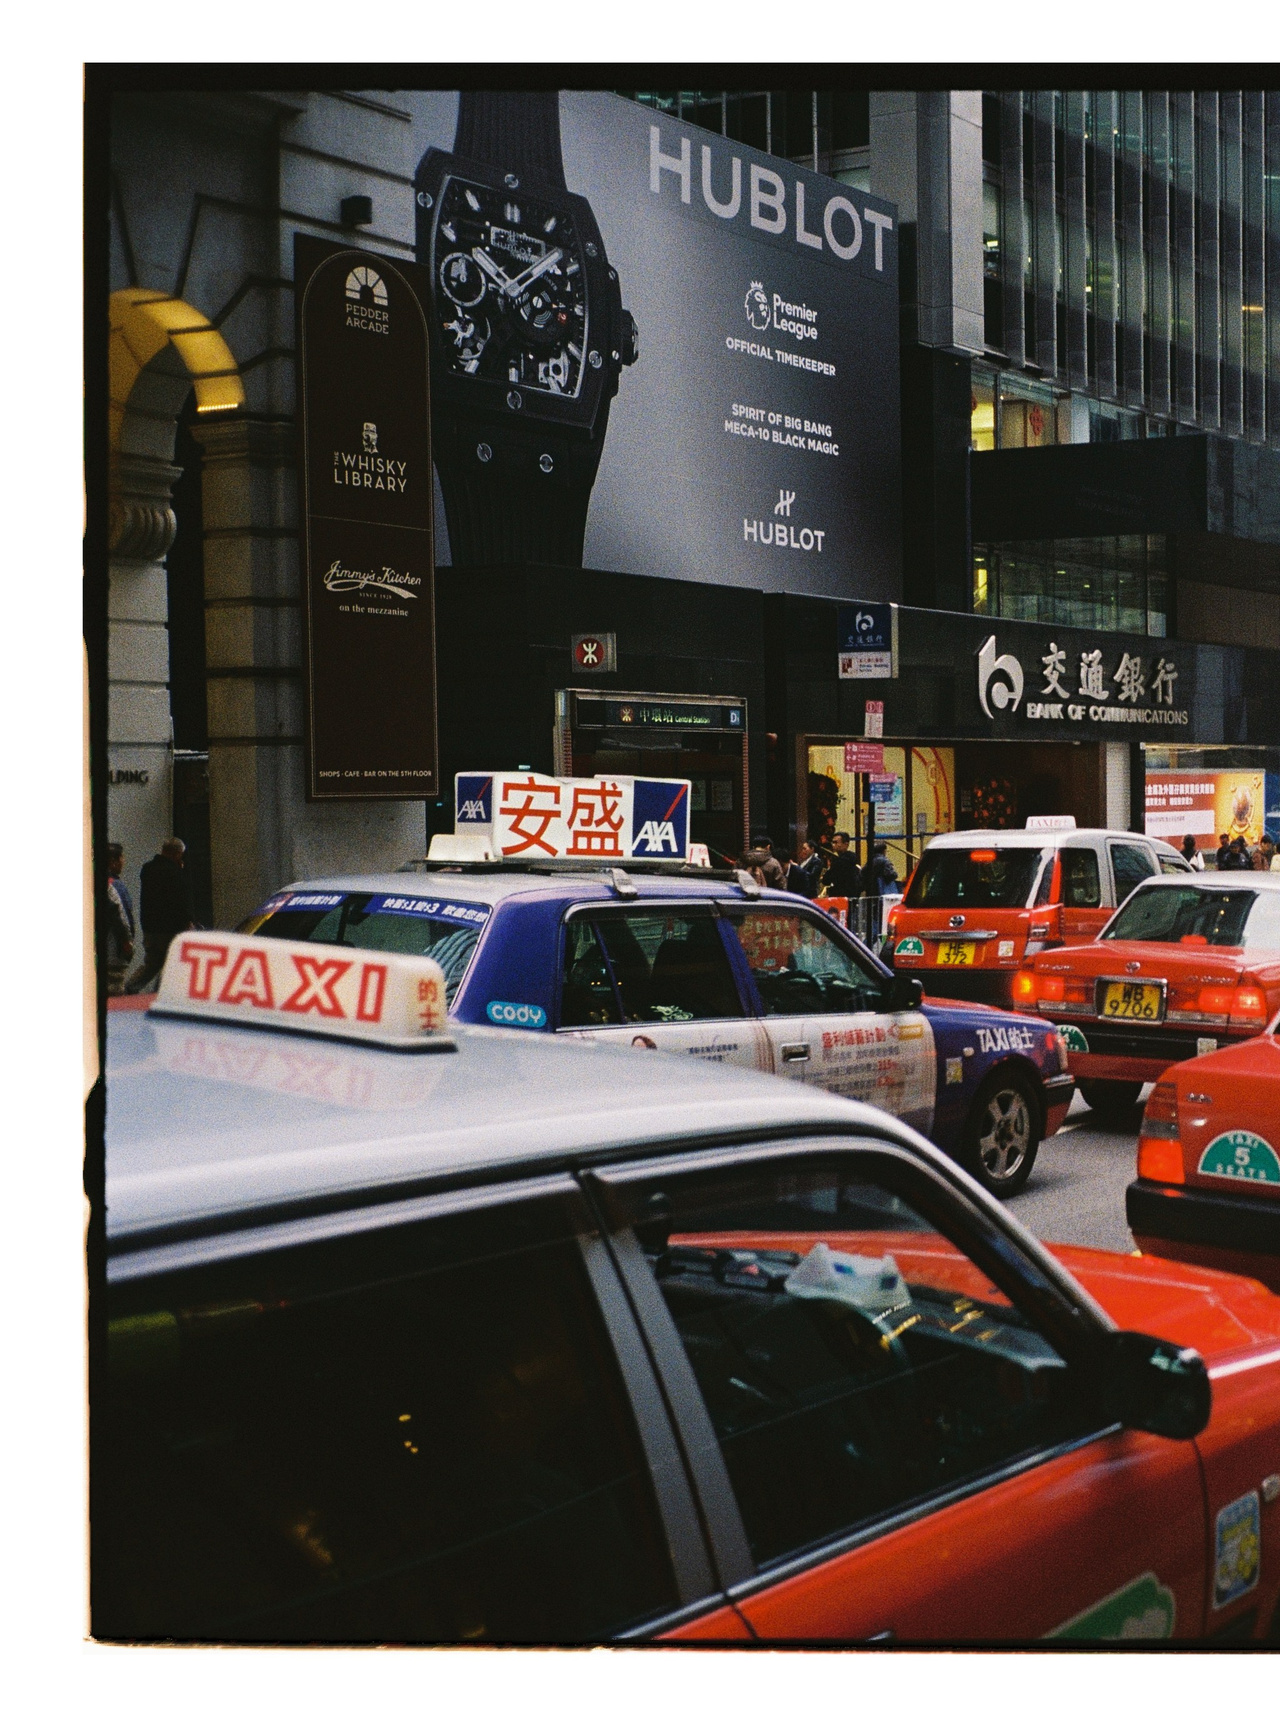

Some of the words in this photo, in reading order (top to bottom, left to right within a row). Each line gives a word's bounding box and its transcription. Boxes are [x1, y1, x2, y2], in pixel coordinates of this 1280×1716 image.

[649, 125, 893, 271] HUBLOT
[345, 303, 389, 322] PEDDER
[773, 293, 817, 323] Premier
[346, 317, 389, 335] ARCADE
[773, 311, 818, 340] League
[726, 337, 774, 361] OFFICIAL
[775, 350, 836, 377] TIMEKEEPER
[732, 404, 766, 423] SPIRIT
[768, 412, 783, 426] OF
[784, 416, 802, 430] BIG
[804, 420, 832, 438] BANG
[724, 420, 770, 441] MECA-10
[772, 431, 806, 450] BLACK
[807, 439, 839, 456] MAGIC
[341, 452, 407, 477] WHISKY
[334, 468, 407, 494] LIBRARY
[743, 518, 825, 552] HUBLOT
[324, 560, 376, 589] Jimmy's
[377, 567, 421, 586] Kitchen
[352, 604, 365, 614] the
[368, 607, 409, 617] mezzanine
[1041, 642, 1178, 705] 交通銀行
[1026, 702, 1064, 719] BANK
[1067, 703, 1086, 720] OF
[1089, 706, 1189, 725] COMMUNICATIONS
[319, 770, 340, 778] SHOPS
[344, 770, 360, 778] CAFE
[458, 800, 486, 820] AXA
[500, 776, 625, 857] 安盛
[632, 820, 678, 853] AXA
[907, 941, 914, 950] 4
[949, 942, 965, 953] HE
[942, 952, 968, 964] 372
[180, 942, 389, 1024] TAXI
[1122, 984, 1145, 1002] WB
[417, 977, 439, 1032] 的士
[491, 1002, 542, 1024] cody
[1109, 1000, 1155, 1018] 9706
[1228, 1135, 1259, 1148] TAXI
[1235, 1147, 1250, 1166] 5
[1216, 1163, 1267, 1180] SEATS
